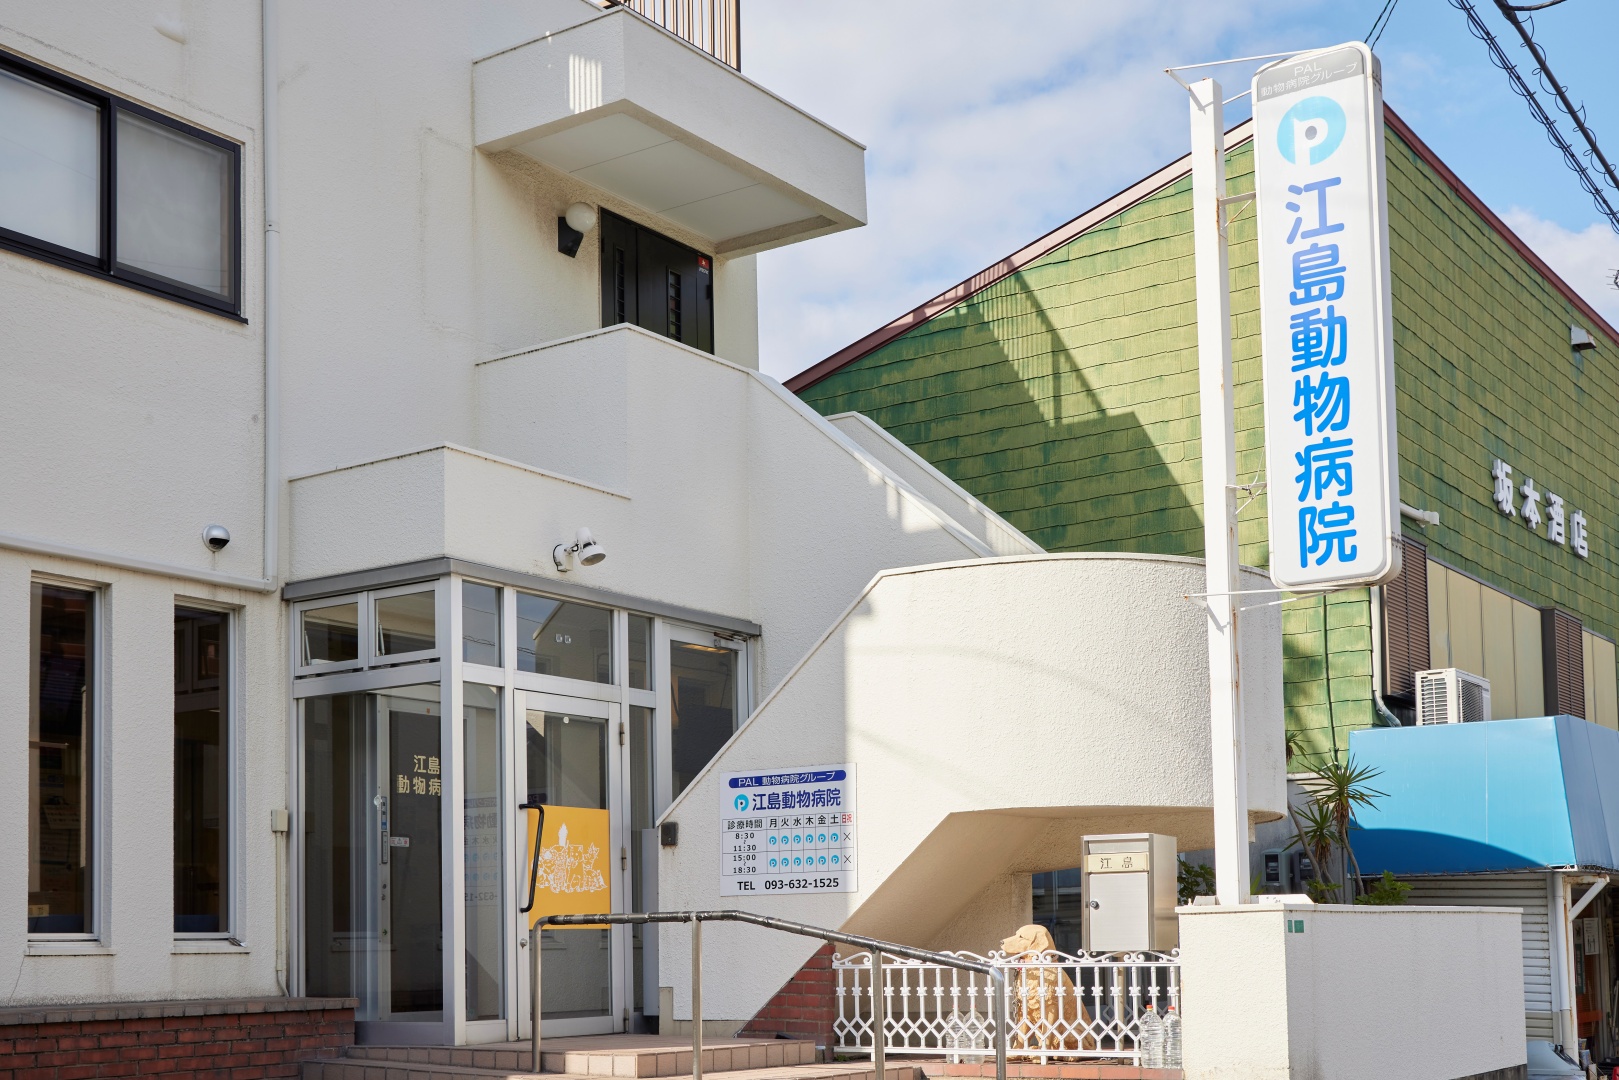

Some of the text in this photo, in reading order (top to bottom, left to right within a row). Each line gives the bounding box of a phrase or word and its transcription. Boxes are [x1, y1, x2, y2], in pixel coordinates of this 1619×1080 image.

[1294, 62, 1322, 76] PAL
[1261, 62, 1357, 97] 動物病院グループ
[1286, 176, 1357, 569] 江島動物病院
[413, 755, 440, 775] 江島
[738, 771, 836, 787] PAL 動物病院グループ
[752, 787, 841, 811] 江島動物病院
[727, 818, 763, 830] 診療時間
[769, 818, 778, 828] 月
[780, 817, 790, 827] 火
[792, 816, 802, 826] 水
[805, 815, 814, 825] 木
[817, 814, 827, 825] 金
[829, 814, 839, 825] 土
[735, 832, 755, 840] 8:30
[733, 866, 757, 874] 18:30
[737, 878, 840, 891] TEL 093-632-1525
